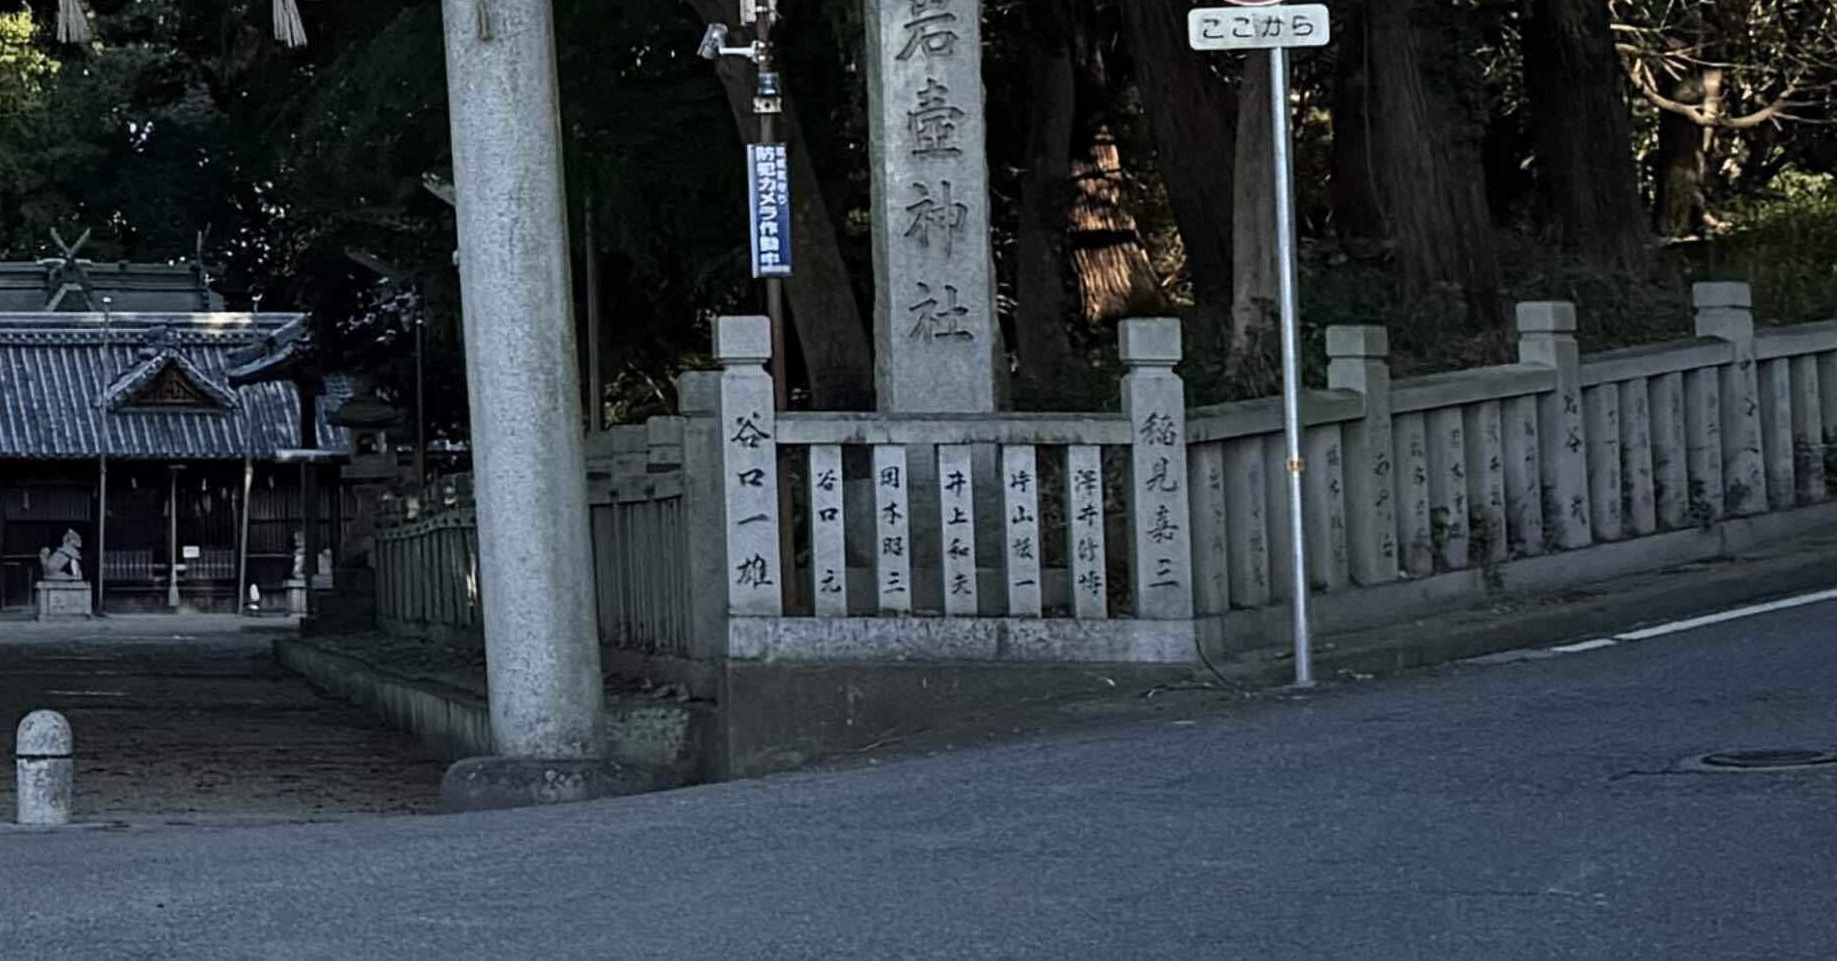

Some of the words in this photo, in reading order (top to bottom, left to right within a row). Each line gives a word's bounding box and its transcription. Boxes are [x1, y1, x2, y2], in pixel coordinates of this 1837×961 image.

[1202, 14, 1314, 40] ここから
[730, 412, 775, 589] 谷口一雄
[817, 469, 843, 593] 谷口元
[945, 469, 972, 595] 井上和夫
